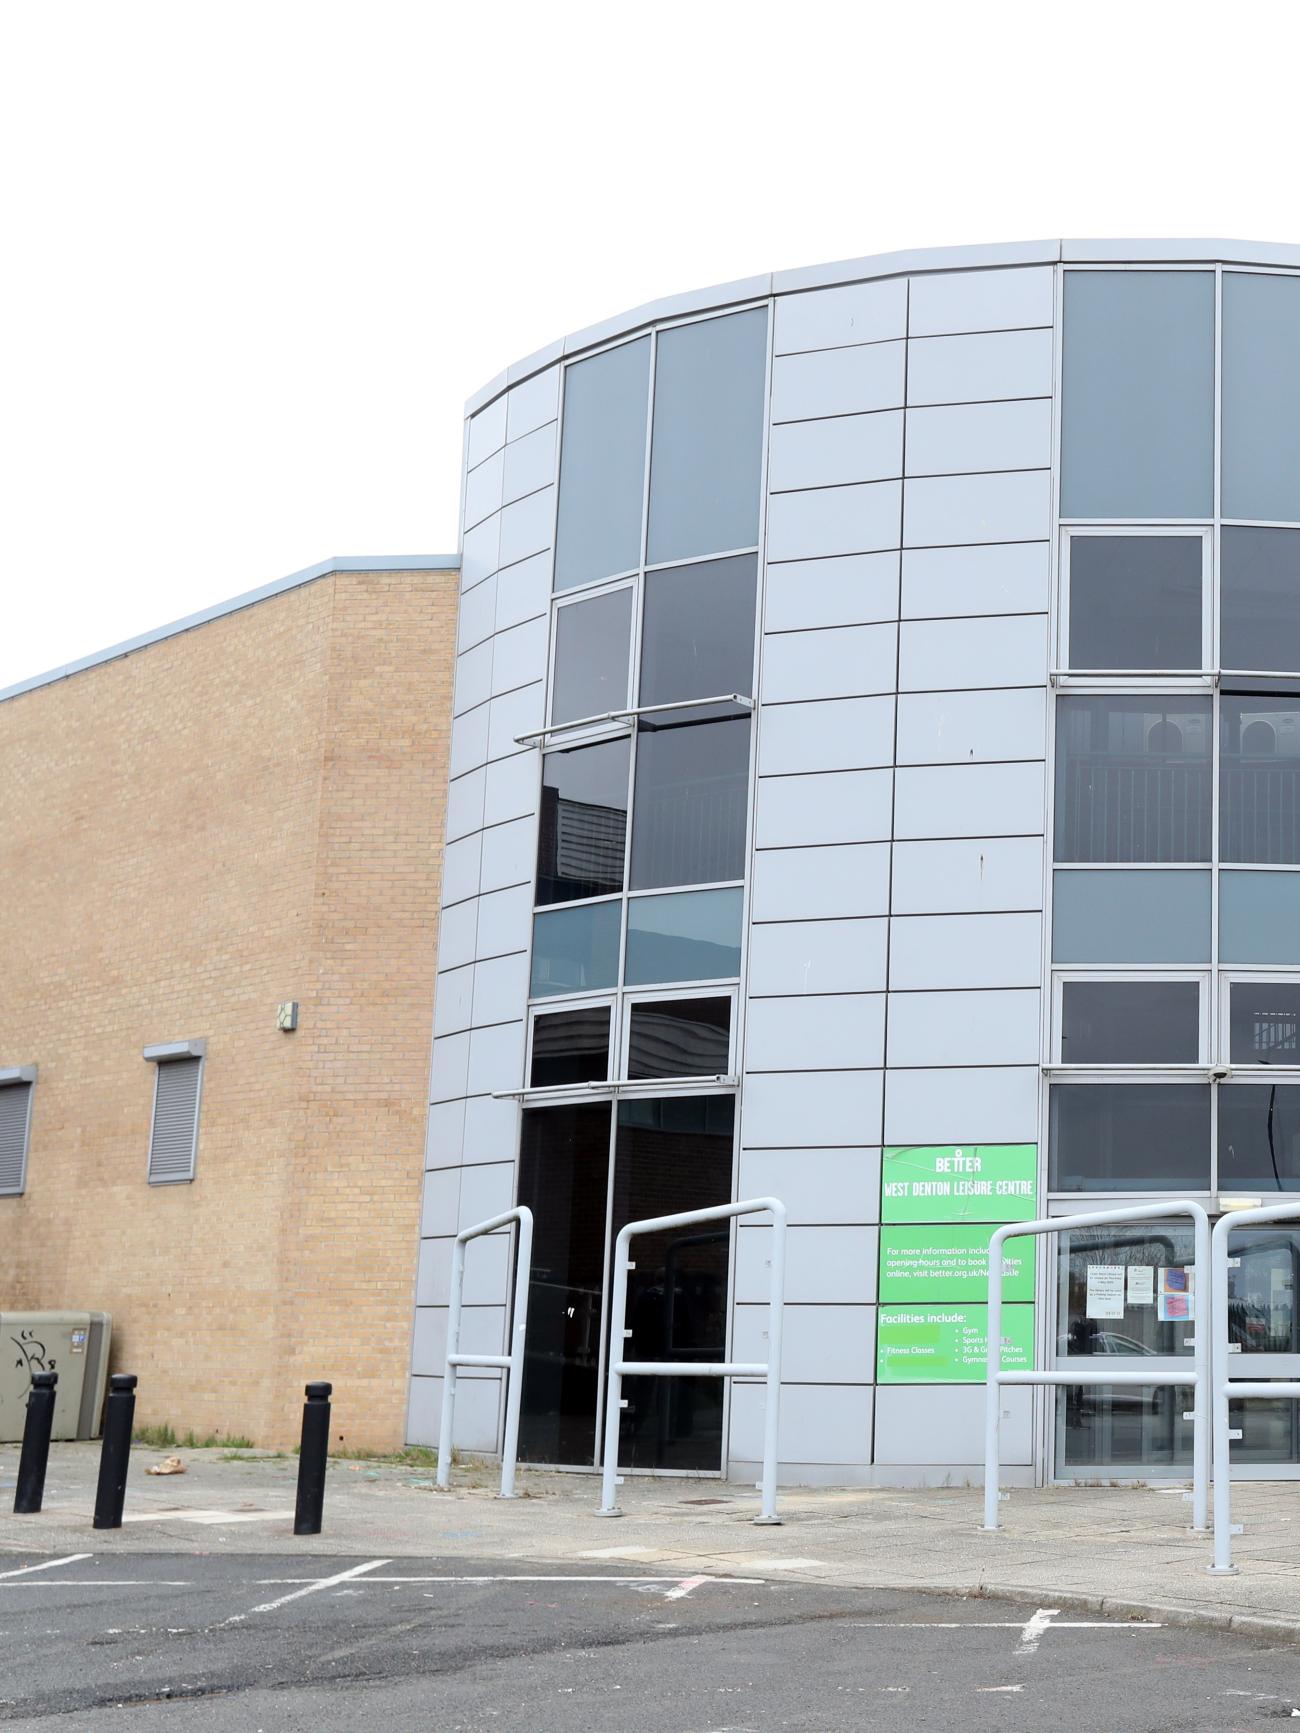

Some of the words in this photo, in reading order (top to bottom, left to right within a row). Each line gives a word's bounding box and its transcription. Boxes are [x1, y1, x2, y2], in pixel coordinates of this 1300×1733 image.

[935, 1149, 982, 1173] BETTER
[884, 1182, 909, 1197] WEST
[912, 1182, 950, 1196] DENTON
[954, 1180, 993, 1196] LEISURE
[996, 1180, 1033, 1195] CENTRE
[887, 1247, 898, 1255] For
[922, 1247, 967, 1255] information
[886, 1258, 918, 1268] opening
[941, 1257, 957, 1266] and
[958, 1257, 967, 1266] to
[967, 1257, 987, 1266] book
[886, 1269, 912, 1279] online,
[913, 1269, 928, 1277] visit
[880, 1313, 925, 1324] Facilities
[927, 1312, 967, 1324] include:
[962, 1326, 979, 1336] Gym
[962, 1337, 984, 1346] Sports
[911, 1346, 935, 1355] Classes
[1001, 1355, 1028, 1364] Courses
